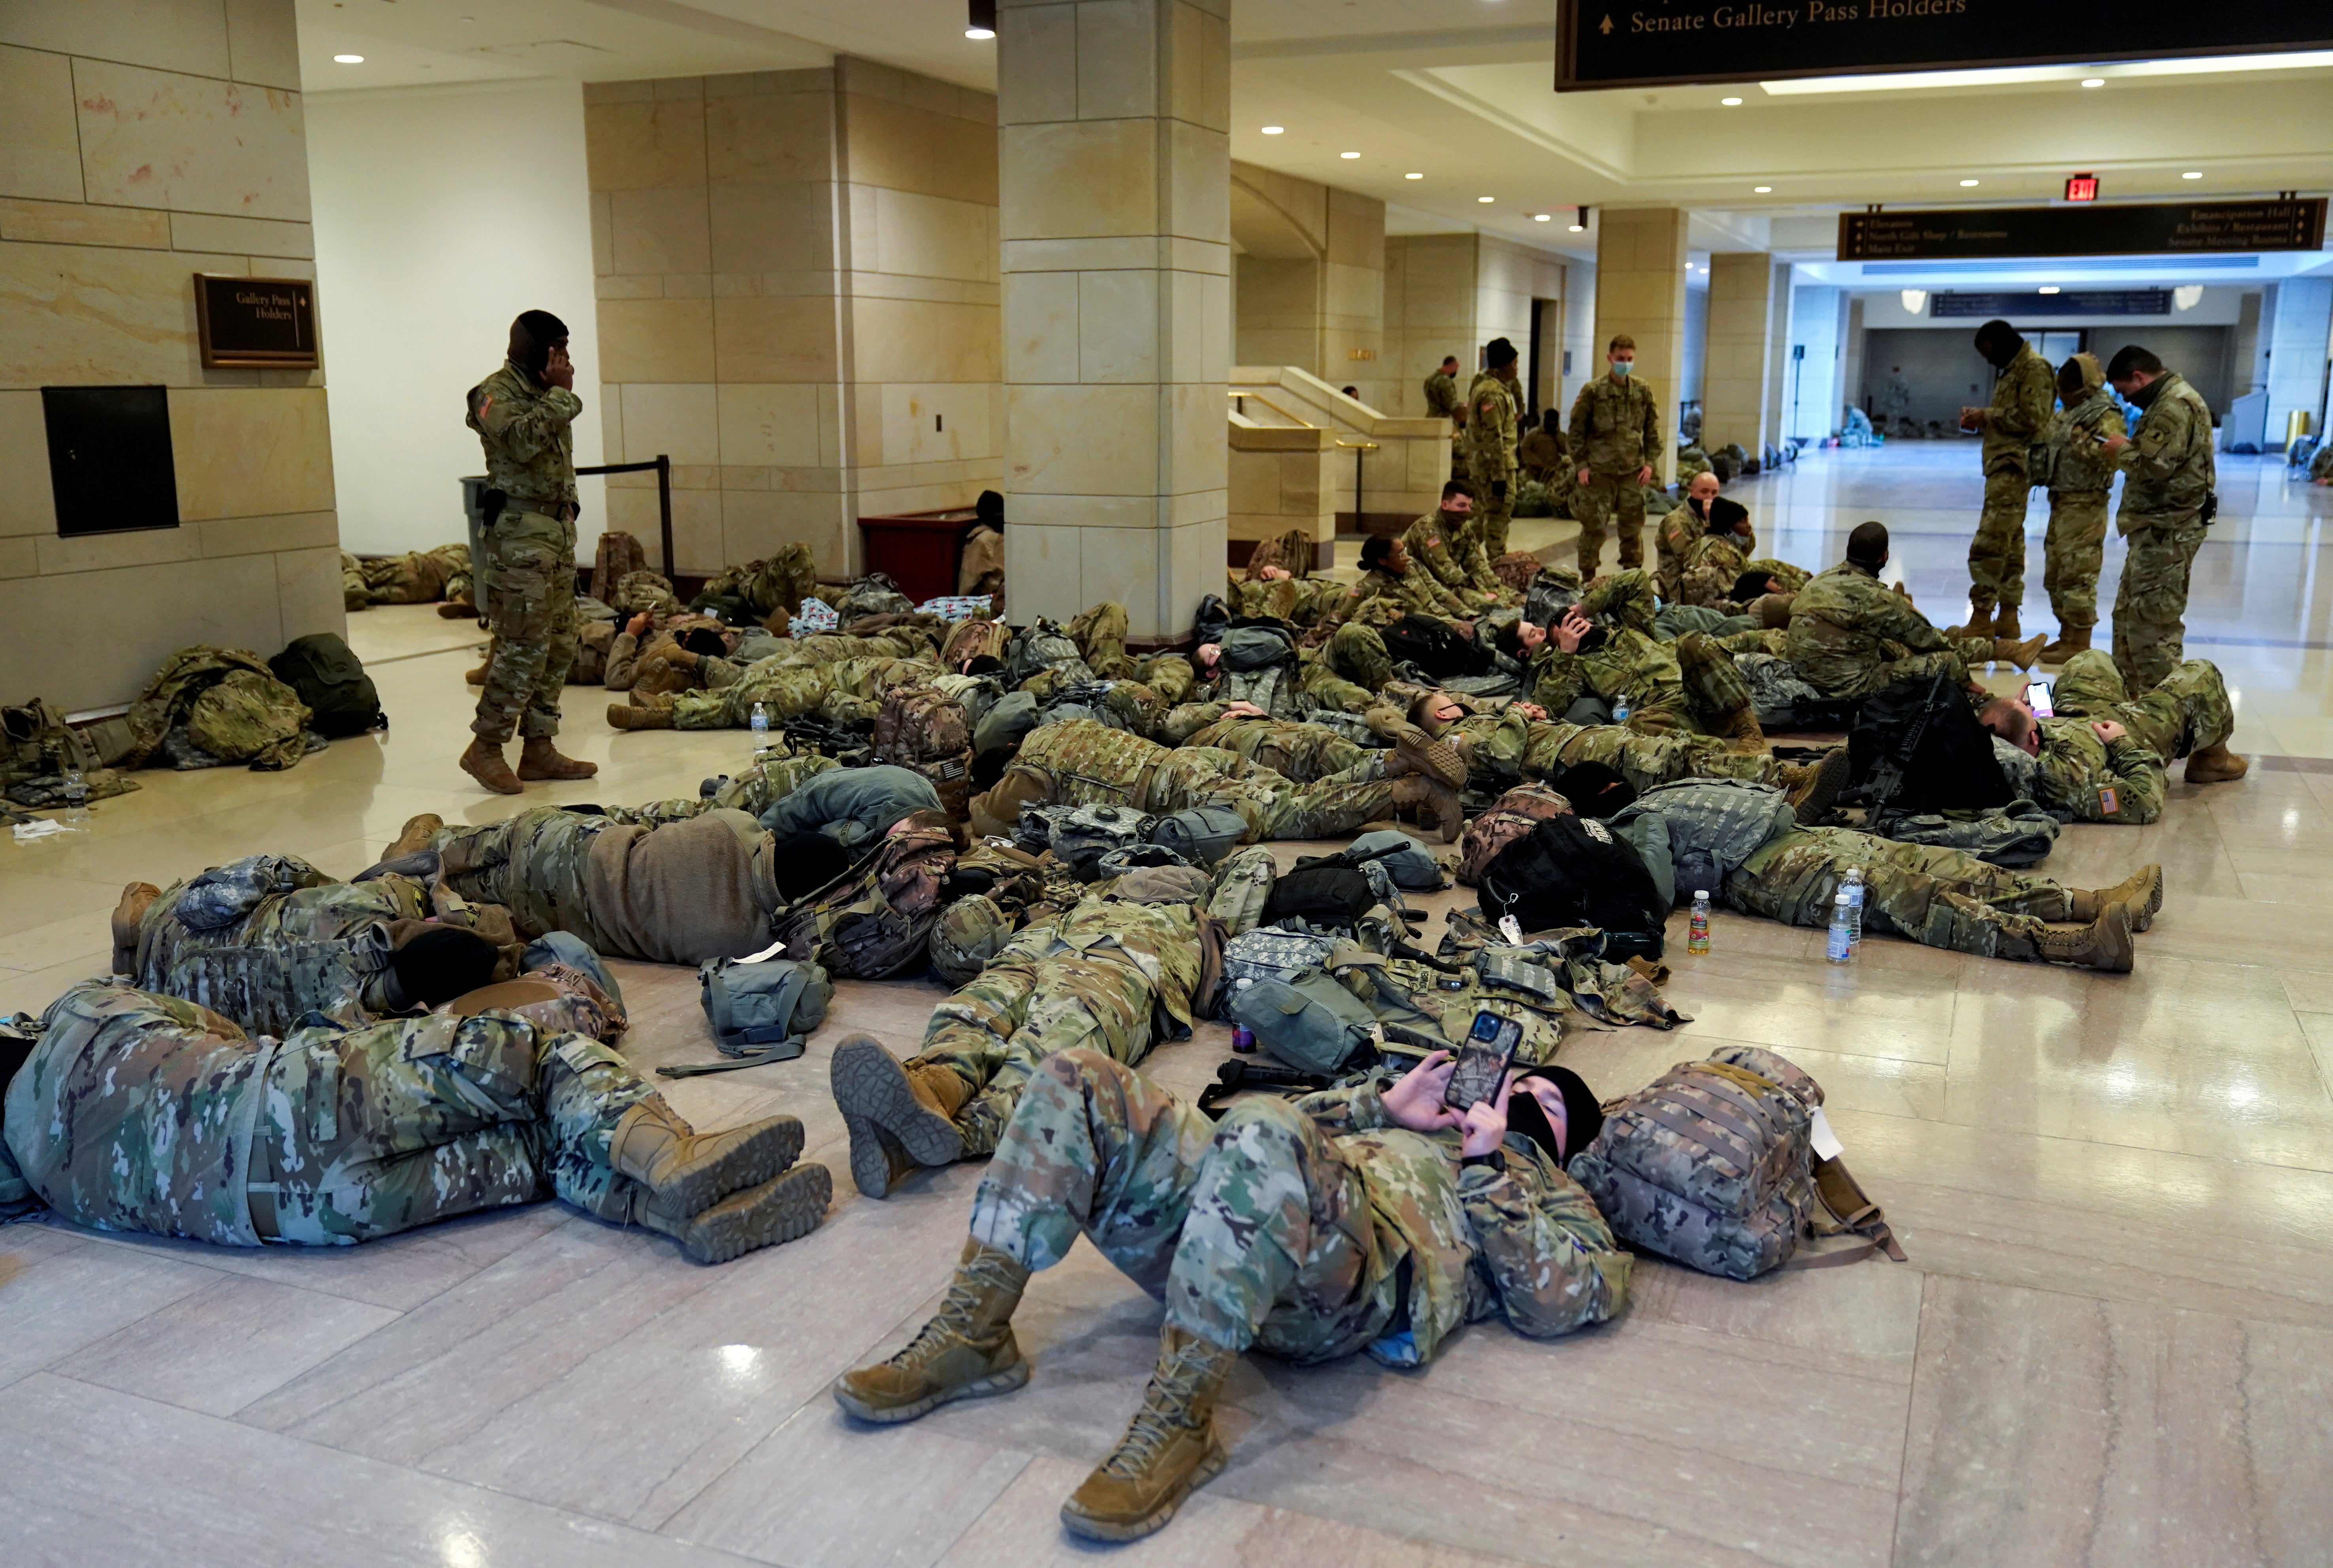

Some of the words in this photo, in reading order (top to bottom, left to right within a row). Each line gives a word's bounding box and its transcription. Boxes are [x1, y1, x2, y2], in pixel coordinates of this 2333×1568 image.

[1632, 11, 1705, 32] Senate
[1714, 4, 1799, 29] Gallery
[1808, 1, 1858, 23] Pass
[1869, 0, 1966, 18] Holders
[2068, 179, 2096, 200] EXIT
[236, 291, 269, 306] Gallery
[272, 293, 290, 306] Pass
[256, 307, 293, 320] Holders
